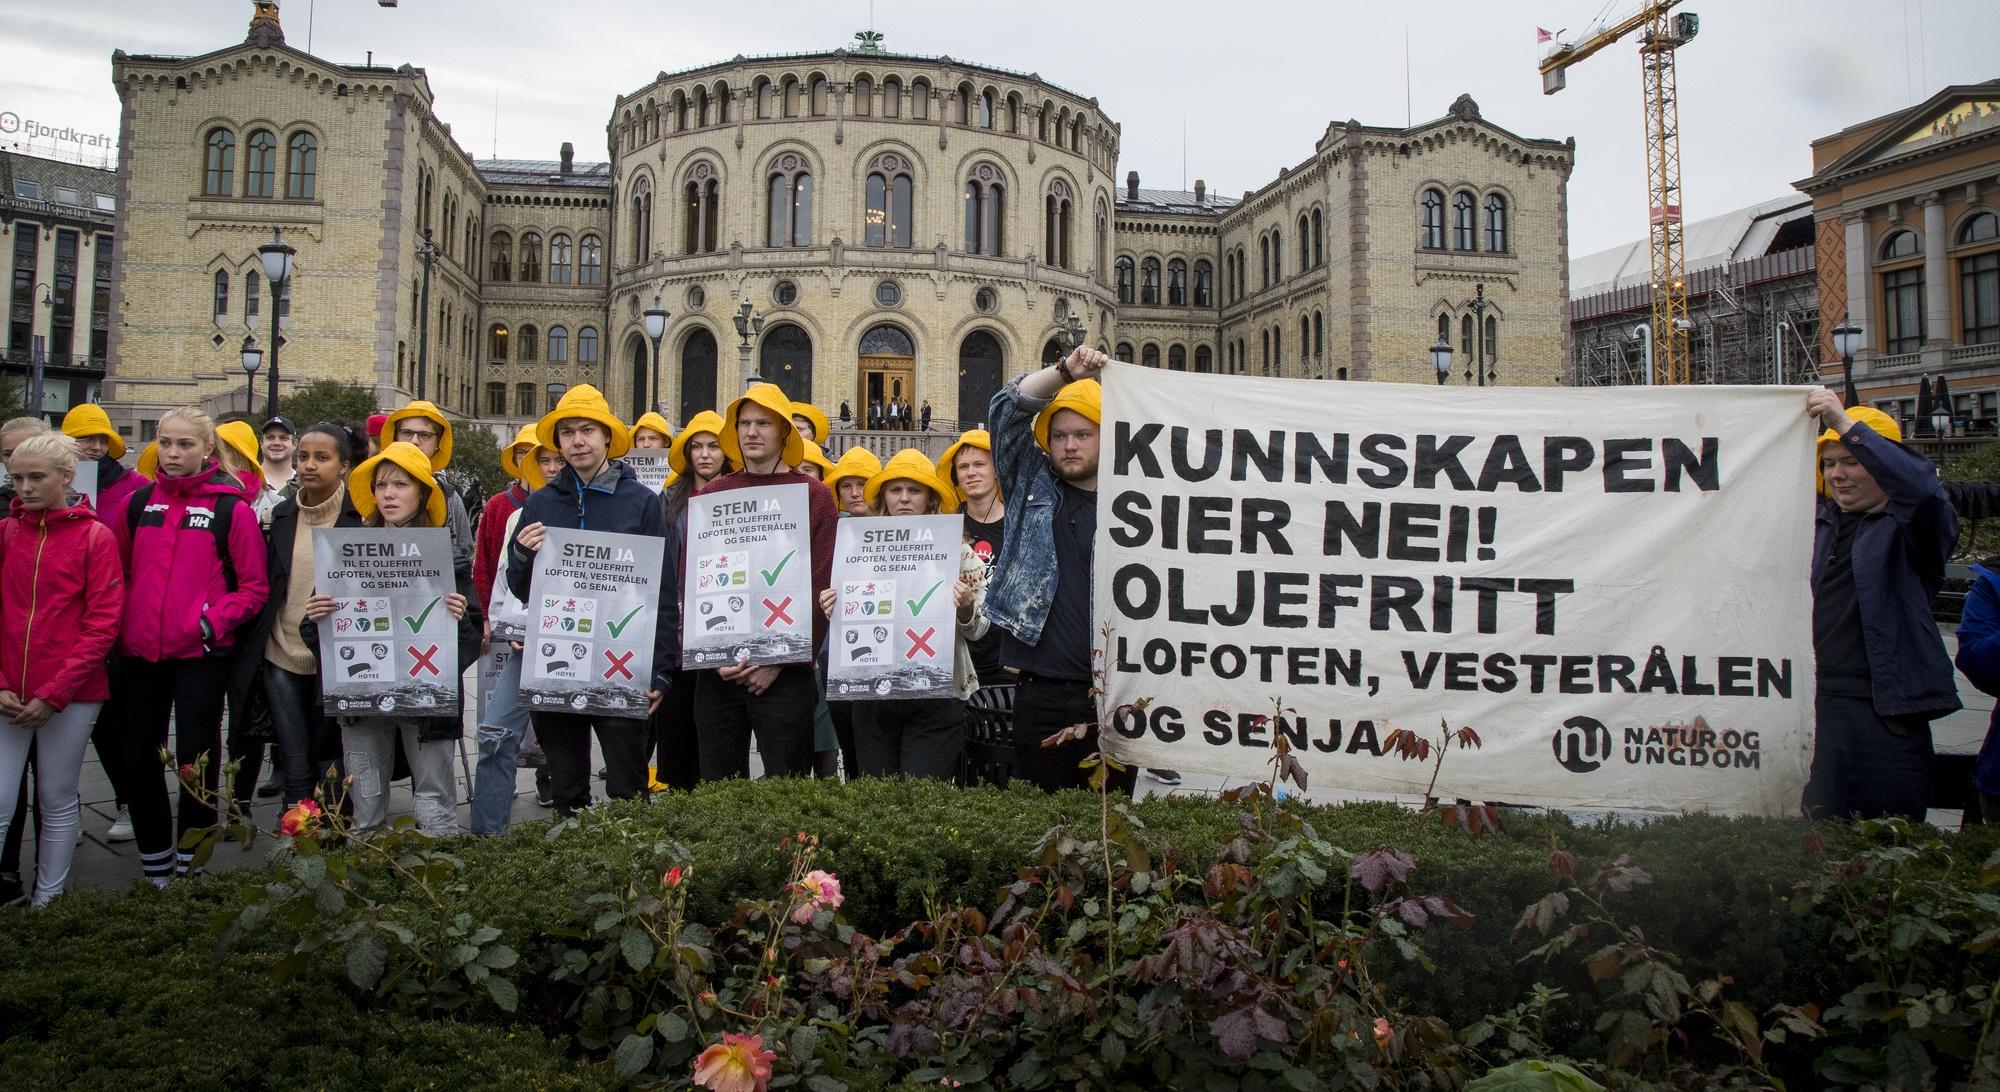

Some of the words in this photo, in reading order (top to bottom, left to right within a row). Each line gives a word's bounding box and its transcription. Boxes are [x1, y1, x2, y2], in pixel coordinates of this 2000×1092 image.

[24, 119, 112, 149] Fjordkraft
[623, 457, 655, 465] STEM
[1113, 421, 1720, 493] KUNNSKAPEN
[712, 500, 757, 518] STEM
[762, 498, 781, 512] JA
[189, 516, 210, 528] HH
[737, 513, 782, 524] OLJEFRITT
[1109, 490, 1293, 555] SIER
[1323, 500, 1497, 563] NEI!
[698, 528, 738, 539] LOFOTEN,
[739, 522, 797, 533] VESTERÅLEN
[863, 529, 910, 543] STEM
[914, 528, 934, 541] JA
[725, 537, 738, 545] OG
[739, 535, 767, 543] SENJA
[342, 543, 394, 557] STEM
[400, 543, 421, 557] JA
[563, 543, 611, 560] STEM
[615, 548, 635, 562] JA
[845, 555, 887, 563] LOFOTEN,
[890, 553, 947, 561] VESTERÅLEN
[327, 570, 375, 579] LOFOTEN,
[377, 569, 440, 577] VESTERÅLEN
[561, 559, 575, 567] TIL
[576, 560, 587, 568] ET
[589, 562, 634, 573] OLJEFRITT
[888, 564, 916, 572] SENJA
[545, 568, 588, 580] LOFOTEN,
[590, 572, 648, 585] VESTERÅLEN
[574, 582, 586, 590] OG
[589, 582, 617, 592] SENJA
[1112, 562, 1575, 635] OLJEFRITT
[1117, 636, 1380, 697] LOFOTEN,
[1401, 644, 1792, 699] VESTERÅLEN
[1113, 703, 1186, 743] OG
[1203, 710, 1384, 756] SENJA
[1624, 726, 1717, 749] NATUR
[1723, 730, 1760, 749] OG
[1624, 746, 1760, 770] UNGDOM
